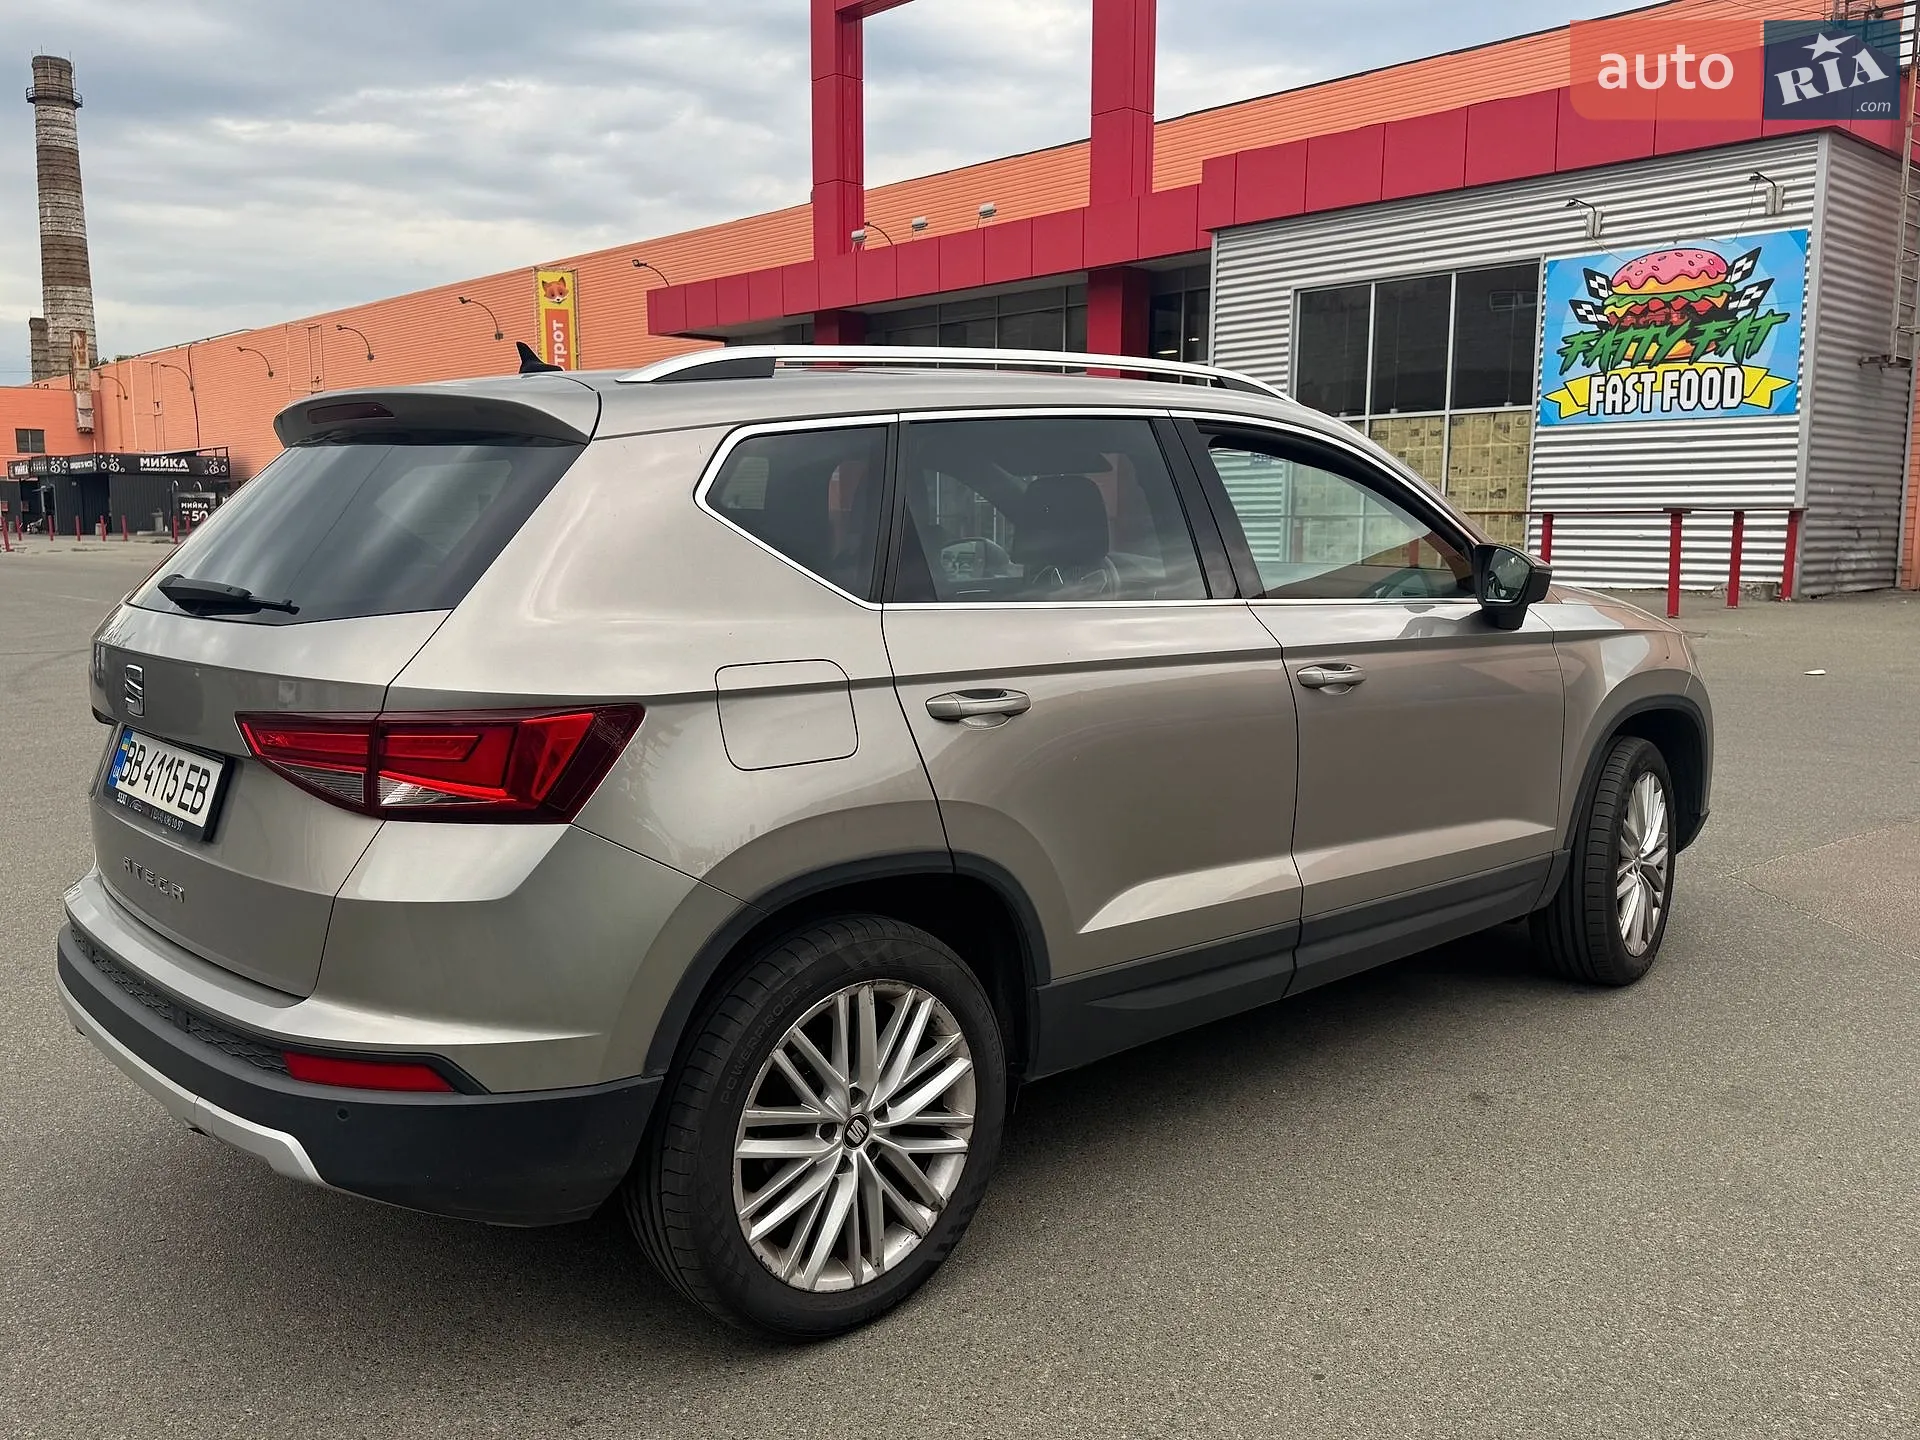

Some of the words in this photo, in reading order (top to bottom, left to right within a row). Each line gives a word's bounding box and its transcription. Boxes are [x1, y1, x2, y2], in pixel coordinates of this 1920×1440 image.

[1557, 318, 1692, 375] FATTY
[1686, 306, 1791, 366] FAT
[1588, 370, 1657, 416] FAST
[1661, 366, 1745, 411] FOOD
[140, 456, 188, 468] МИЙКА
[181, 501, 208, 509] МИЙКА
[118, 740, 147, 786] BB
[144, 750, 185, 804] 4115
[177, 765, 211, 815] EB
